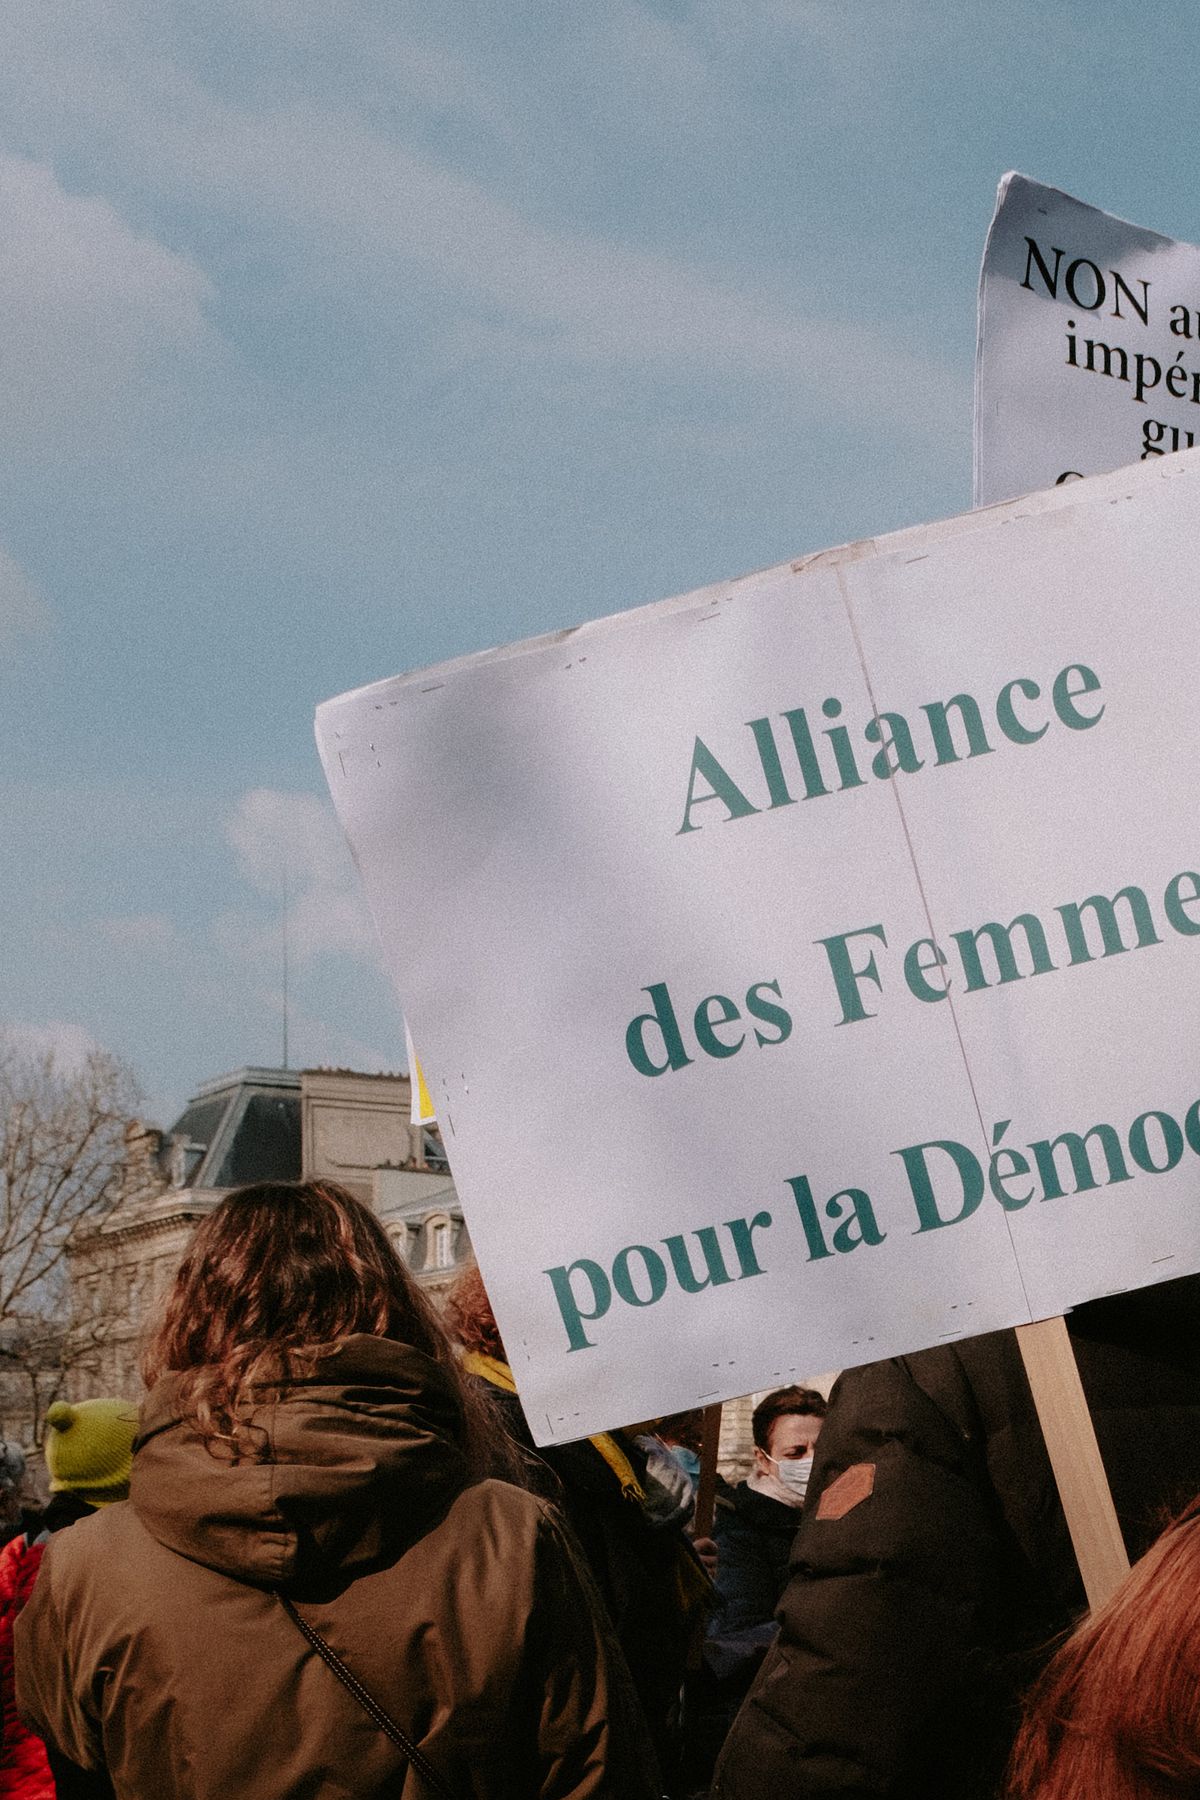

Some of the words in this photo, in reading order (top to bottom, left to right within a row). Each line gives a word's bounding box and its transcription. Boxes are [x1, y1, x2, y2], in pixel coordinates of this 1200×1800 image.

[1019, 236, 1151, 326] NON
[675, 661, 1105, 835] Alliance
[624, 978, 793, 1077] des
[543, 1208, 772, 1354] pour
[786, 1173, 886, 1263] la
